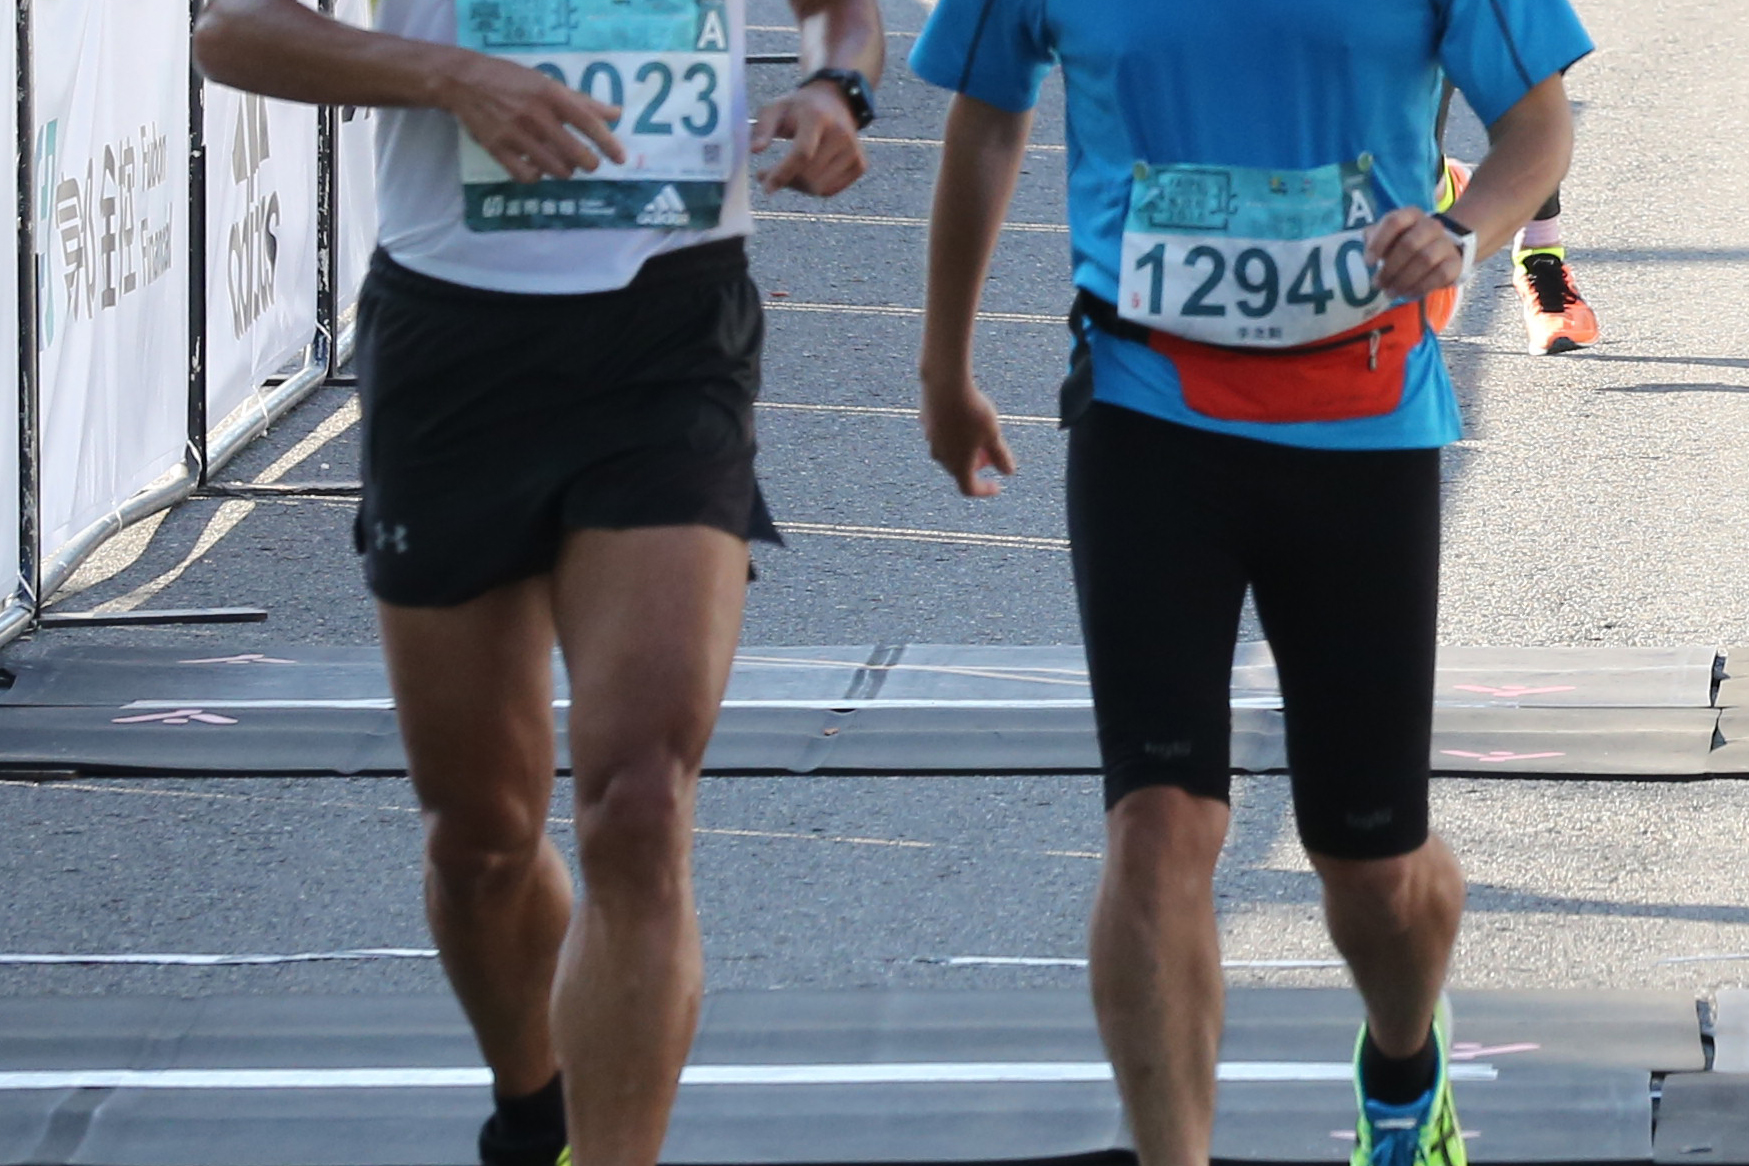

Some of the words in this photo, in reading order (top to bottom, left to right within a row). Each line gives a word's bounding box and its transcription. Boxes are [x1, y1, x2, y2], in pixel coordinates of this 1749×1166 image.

[696, 11, 726, 50] A
[530, 60, 719, 138] 023
[1346, 190, 1374, 230] A
[1134, 239, 1381, 318] 12940
